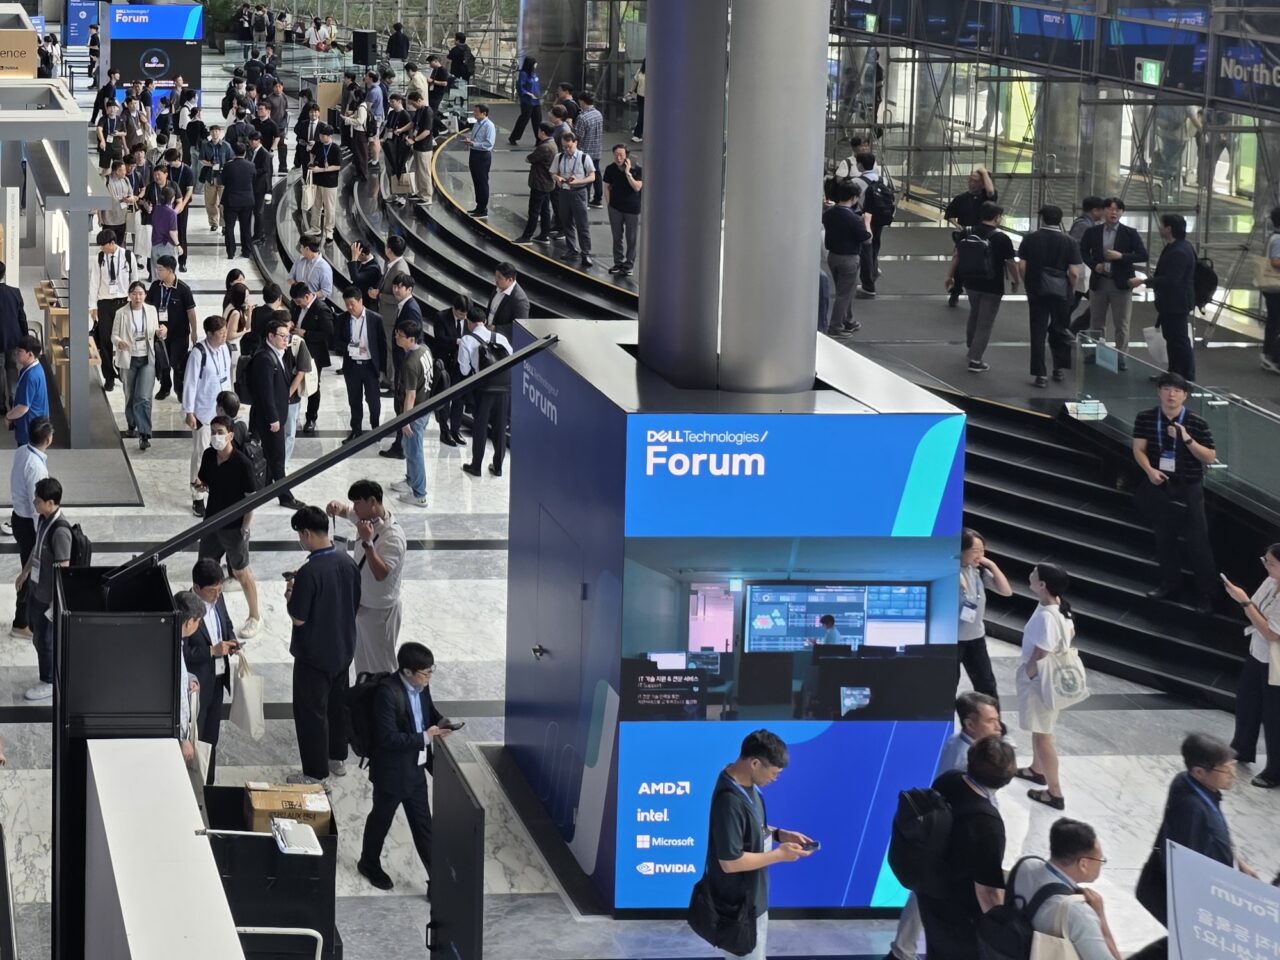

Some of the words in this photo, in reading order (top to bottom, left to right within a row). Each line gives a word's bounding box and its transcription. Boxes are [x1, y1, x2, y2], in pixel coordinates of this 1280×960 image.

[115, 14, 149, 23] Forum
[523, 371, 558, 425] Forum
[646, 445, 765, 476] Forum
[638, 782, 675, 795] AMD
[652, 836, 694, 847] Microsoft
